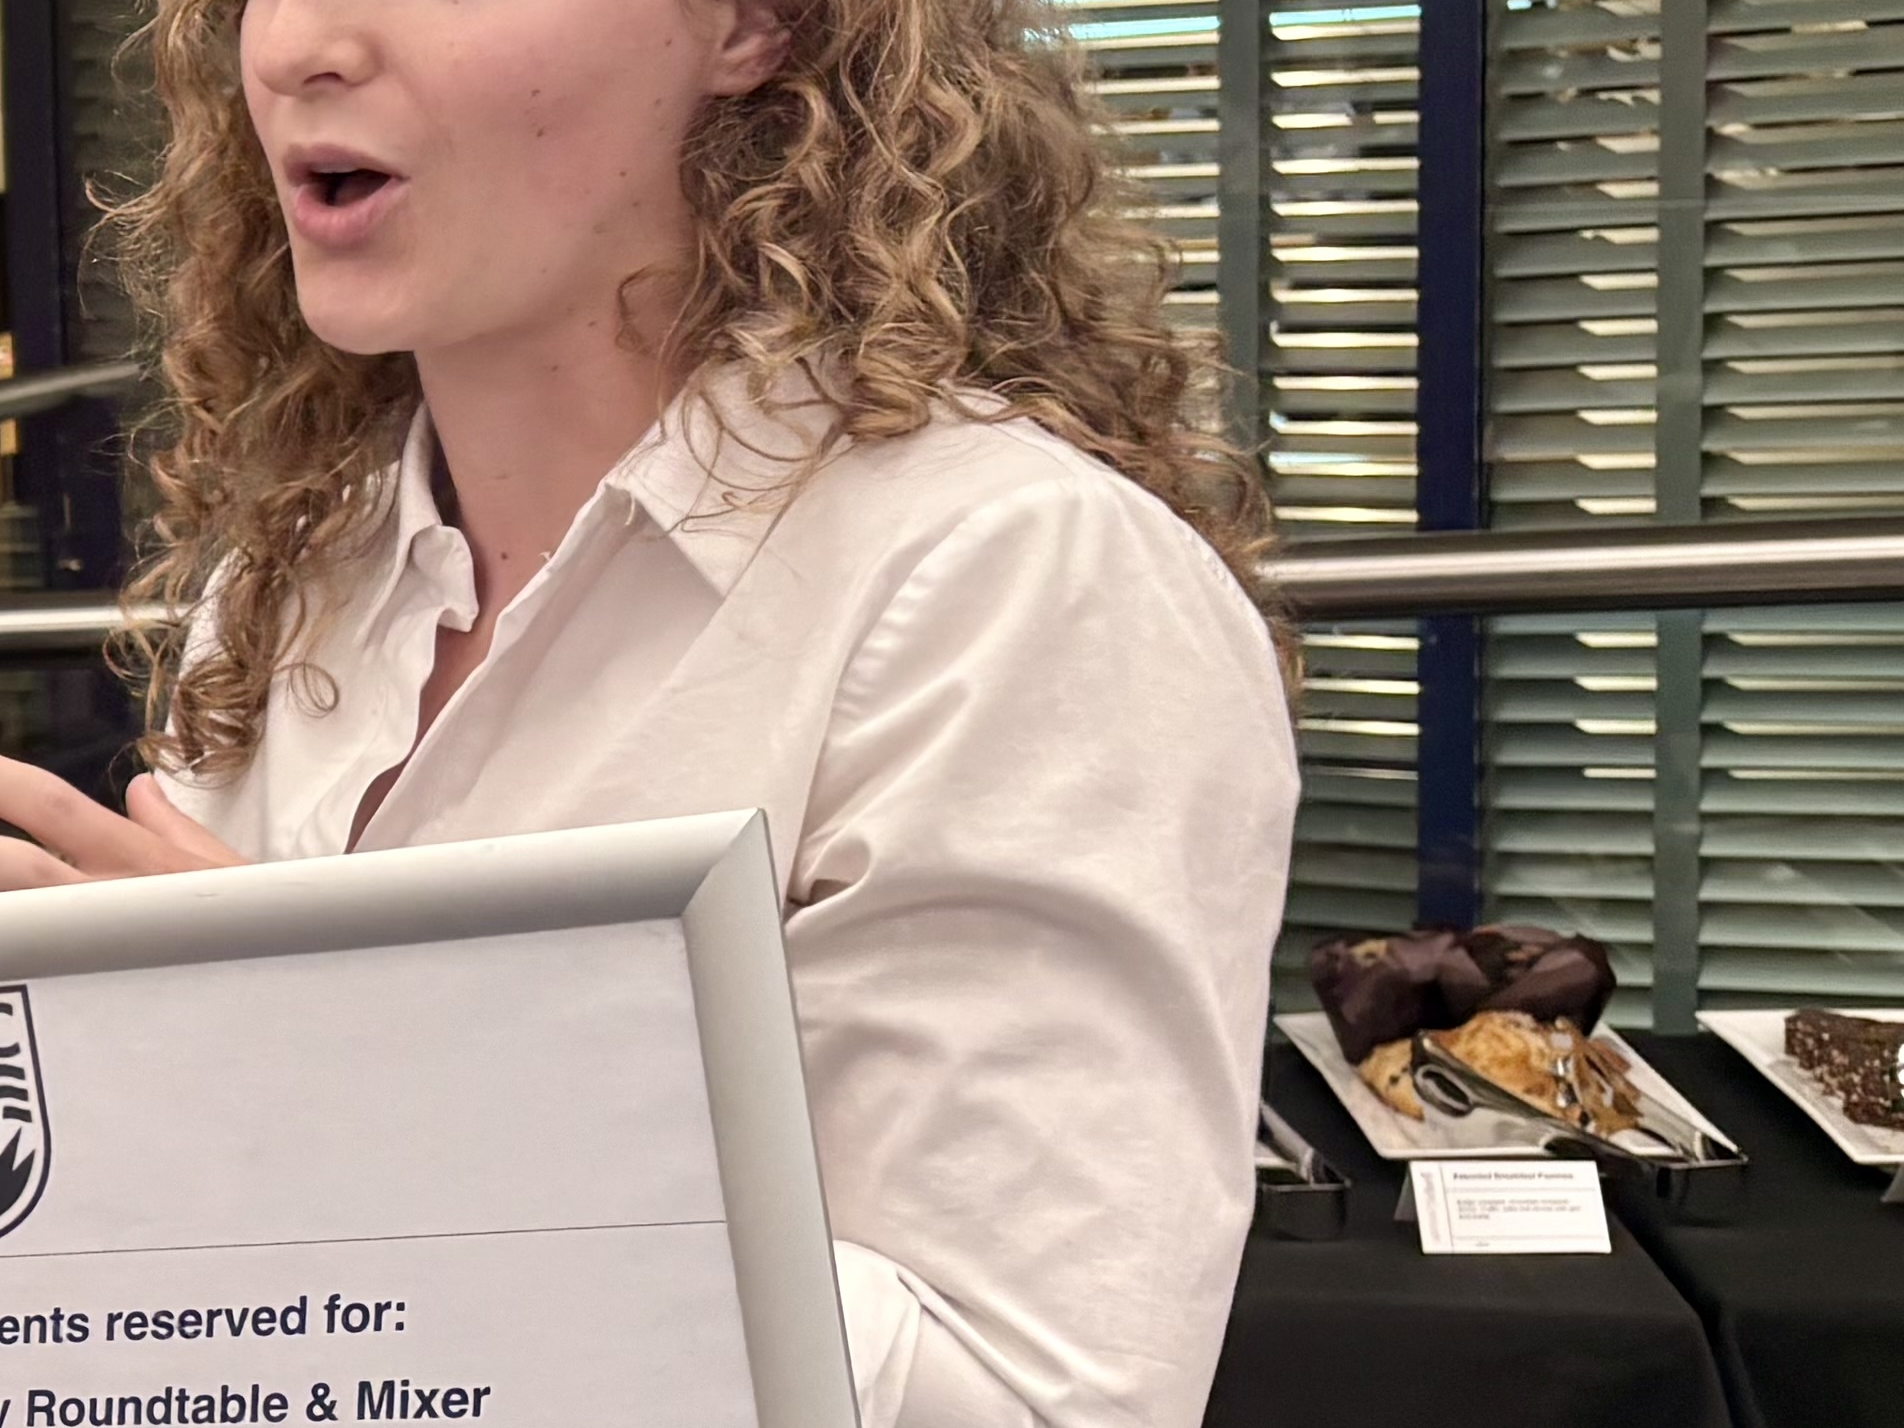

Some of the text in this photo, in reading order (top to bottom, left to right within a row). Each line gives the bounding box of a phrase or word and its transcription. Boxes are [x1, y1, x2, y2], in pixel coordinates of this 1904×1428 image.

[105, 1294, 308, 1341] reserved
[322, 1292, 406, 1334] for:
[25, 1383, 290, 1428] Roundtable
[305, 1381, 340, 1422] &
[356, 1378, 492, 1420] Mixer
